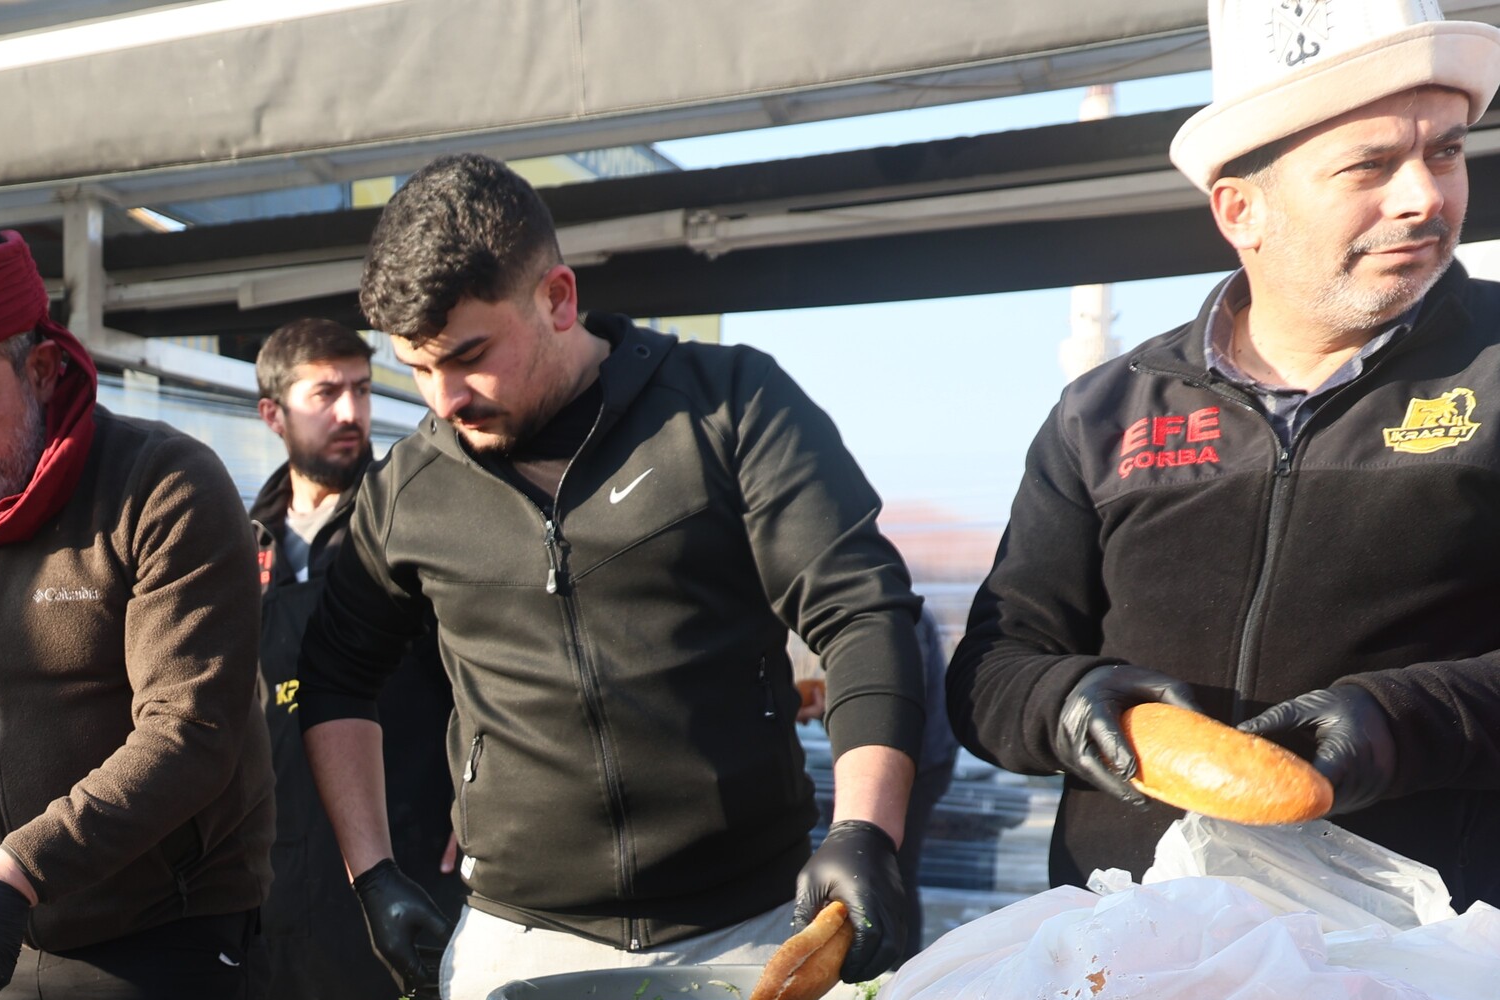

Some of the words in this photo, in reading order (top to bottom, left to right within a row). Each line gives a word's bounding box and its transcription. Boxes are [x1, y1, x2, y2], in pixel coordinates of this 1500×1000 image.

[1120, 406, 1221, 457] EFE
[1118, 446, 1220, 479] ÇORBA
[44, 586, 99, 602] Columbia
